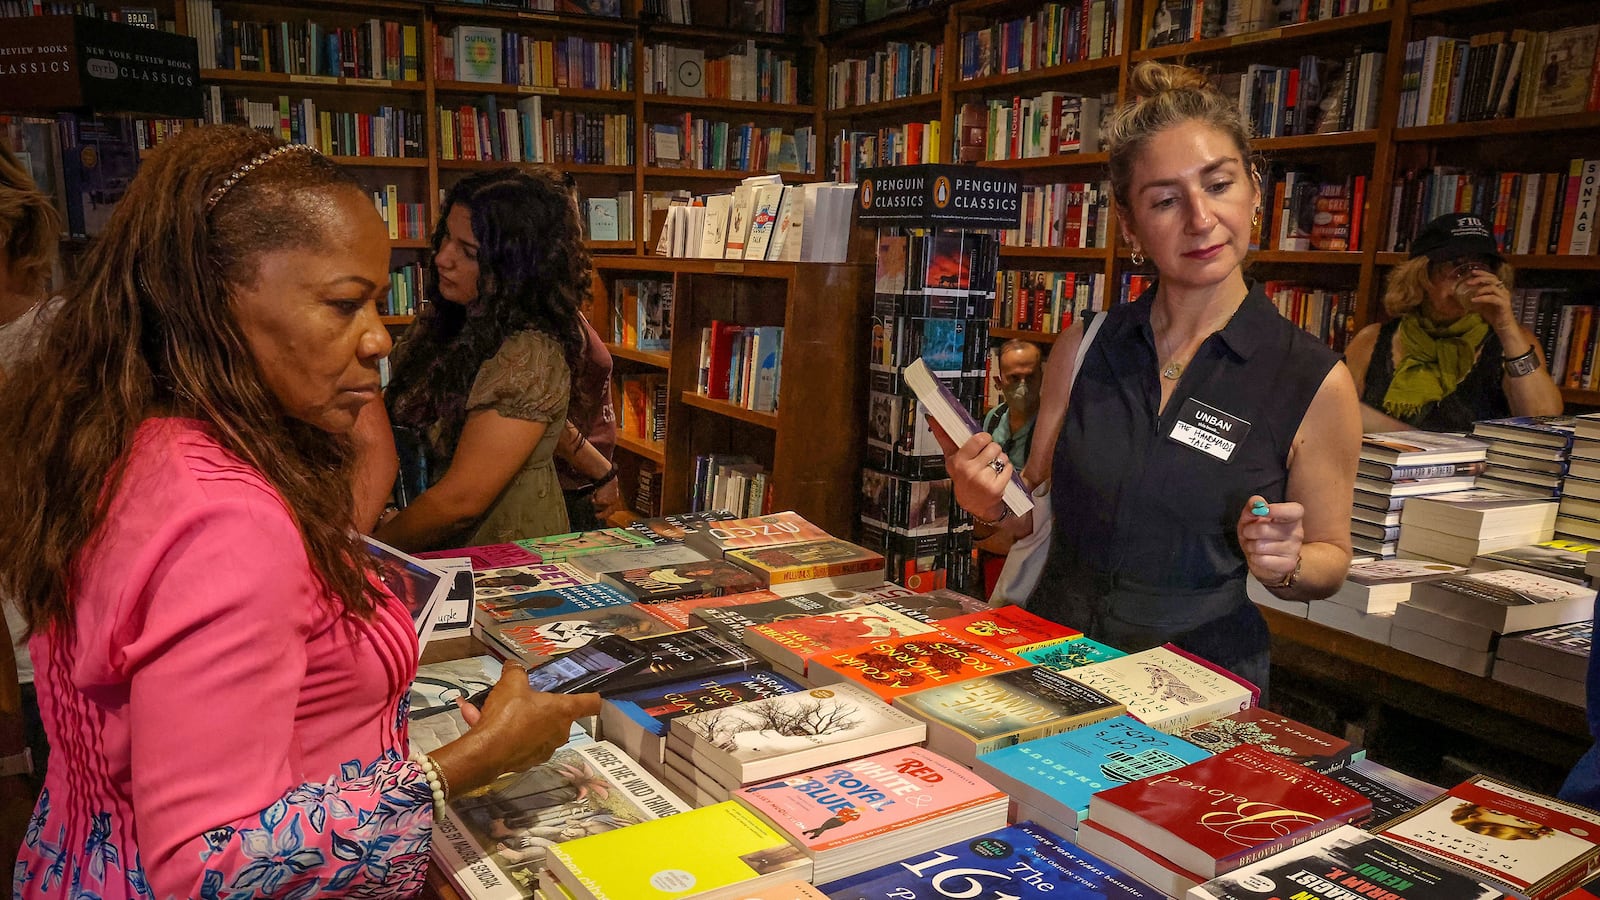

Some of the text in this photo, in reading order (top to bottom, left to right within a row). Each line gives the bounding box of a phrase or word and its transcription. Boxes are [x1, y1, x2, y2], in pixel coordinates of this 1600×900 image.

[38, 45, 68, 54] BOOKS
[464, 35, 496, 44] OUTLIVE
[0, 61, 70, 75] LASSICS
[86, 47, 192, 69] NEW YORK REVIEW BOOKS
[91, 61, 193, 87] nyrb CLASSICS
[1011, 96, 1020, 138] LEBRON
[876, 178, 925, 191] PENGUIN
[955, 178, 1018, 195] PENGUIN
[875, 195, 924, 208] CLASSICS
[954, 196, 1017, 211] CLASSICS
[1578, 163, 1596, 232] SONTAG
[1195, 410, 1232, 432] UNBAN
[1188, 436, 1212, 450] TALE
[527, 564, 582, 586] PET
[554, 588, 591, 610] DAUGHTER
[568, 586, 605, 607] MEXICAN
[582, 584, 621, 605] PERFECT
[438, 608, 457, 623] urple
[704, 608, 742, 633] NGER
[880, 600, 937, 624] PURPLE
[754, 625, 801, 650] CATCHER
[785, 628, 811, 642] RYE
[941, 631, 969, 646] MAAS
[657, 642, 694, 662] CROW
[903, 643, 930, 656] AND
[927, 641, 994, 672] ROSES
[980, 647, 1016, 666] SARAH
[832, 653, 909, 689] A COURT
[872, 644, 949, 682] THORNS
[894, 667, 913, 678] OF
[750, 673, 791, 697] SARAH
[1070, 684, 1106, 704] KHALED
[1074, 672, 1152, 714] SALMAN
[1083, 669, 1168, 713] RUSHDIE
[664, 692, 704, 714] GLAS
[700, 696, 719, 706] OF
[941, 696, 1007, 723] KITE
[961, 680, 1060, 724] RUNNER
[1095, 730, 1138, 751] CAT'S
[1108, 722, 1169, 748] CRADLE
[1260, 718, 1332, 748] HARPER LEE
[584, 745, 616, 769] WHERE
[616, 764, 636, 782] THE
[628, 777, 655, 798] WILD
[1017, 746, 1103, 790] ONNEGUT
[1027, 765, 1067, 786] KURT
[1232, 752, 1302, 785] Morrison
[825, 769, 897, 812] ROYAL
[845, 759, 933, 809] WHITE &
[1304, 783, 1348, 806] Toni
[1338, 776, 1392, 804] BALDWIN
[794, 778, 857, 815] BLUE
[1148, 774, 1326, 849] Beloved
[980, 840, 1004, 856] hulu
[1239, 823, 1341, 867] BELOVED Toni Morrison
[1413, 833, 1513, 870] DREAMING
[1427, 830, 1518, 863] IN CUBAN
[455, 838, 482, 866] MAURICE
[470, 862, 503, 890] SENDAK
[900, 851, 1023, 900] 16
[1032, 850, 1048, 860] NEW
[1048, 858, 1073, 875] ORIGIN
[1072, 874, 1099, 889] STORY
[1033, 833, 1052, 846] NEW
[1053, 844, 1078, 860] YORK
[1077, 859, 1105, 877] TIMES
[1104, 874, 1144, 898] bestseller
[1325, 866, 1343, 879] X.
[1006, 861, 1056, 892] The
[1352, 863, 1415, 891] KENDI
